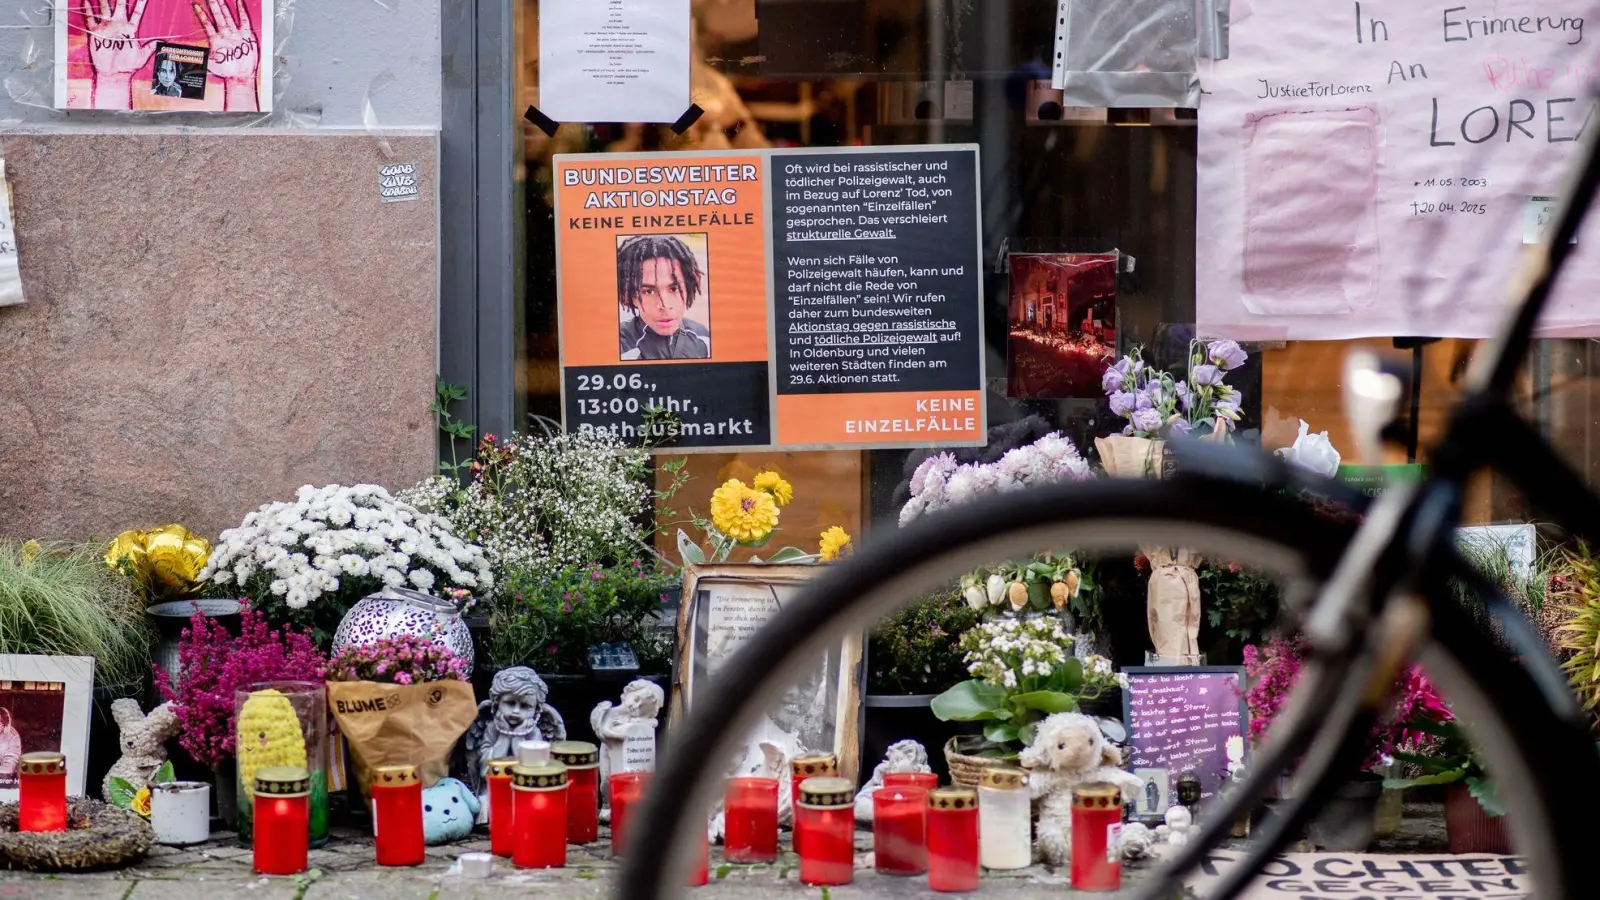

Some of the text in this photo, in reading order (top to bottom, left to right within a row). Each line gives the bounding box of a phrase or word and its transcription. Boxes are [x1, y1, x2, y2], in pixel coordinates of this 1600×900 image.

[1355, 1, 1585, 45] In Erinnerung
[1387, 60, 1428, 84] An
[785, 161, 947, 173] Oft wird bei rassistischer und
[564, 165, 757, 186] BUNDESWEITER
[785, 175, 946, 187] tödlicher Polizeigewalt, auch
[584, 189, 736, 209] AKTIONSTAG
[786, 191, 800, 200] im
[804, 190, 838, 201] Bezug
[842, 189, 860, 199] auf
[906, 188, 929, 198] Tod,
[932, 188, 952, 196] von
[786, 203, 860, 215] sogenannten
[570, 211, 754, 229] KEINE EINZELFÄLLE
[786, 214, 947, 228] gesprochen. Das verschleiert
[786, 228, 896, 241] strukturelle Gewalt.
[788, 255, 898, 266] Wenn sich Fälle von
[788, 266, 963, 280] Polizeigewalt häufen, kann und
[788, 281, 917, 292] darf nicht die Rede von
[864, 294, 889, 304] sein!
[893, 293, 912, 303] Wir
[916, 292, 945, 302] rufen
[789, 306, 932, 318] daher zum bundesweiten
[789, 319, 956, 333] Aktionstag gegen rassistische
[790, 332, 961, 345] und tödliche Polizeigewalt auf!
[790, 346, 925, 358] In Oldenburg und vielen
[790, 359, 947, 371] weiteren Städten finden am
[577, 374, 656, 391] 29.06.,
[790, 373, 900, 384] 29.6. Aktionen statt.
[578, 396, 698, 415] 13:00 Uhr,
[916, 398, 974, 412] KEINE
[845, 416, 975, 433] EINZELFÄLLE
[336, 698, 386, 713] BLUME
[1266, 878, 1520, 892] GEGEN
